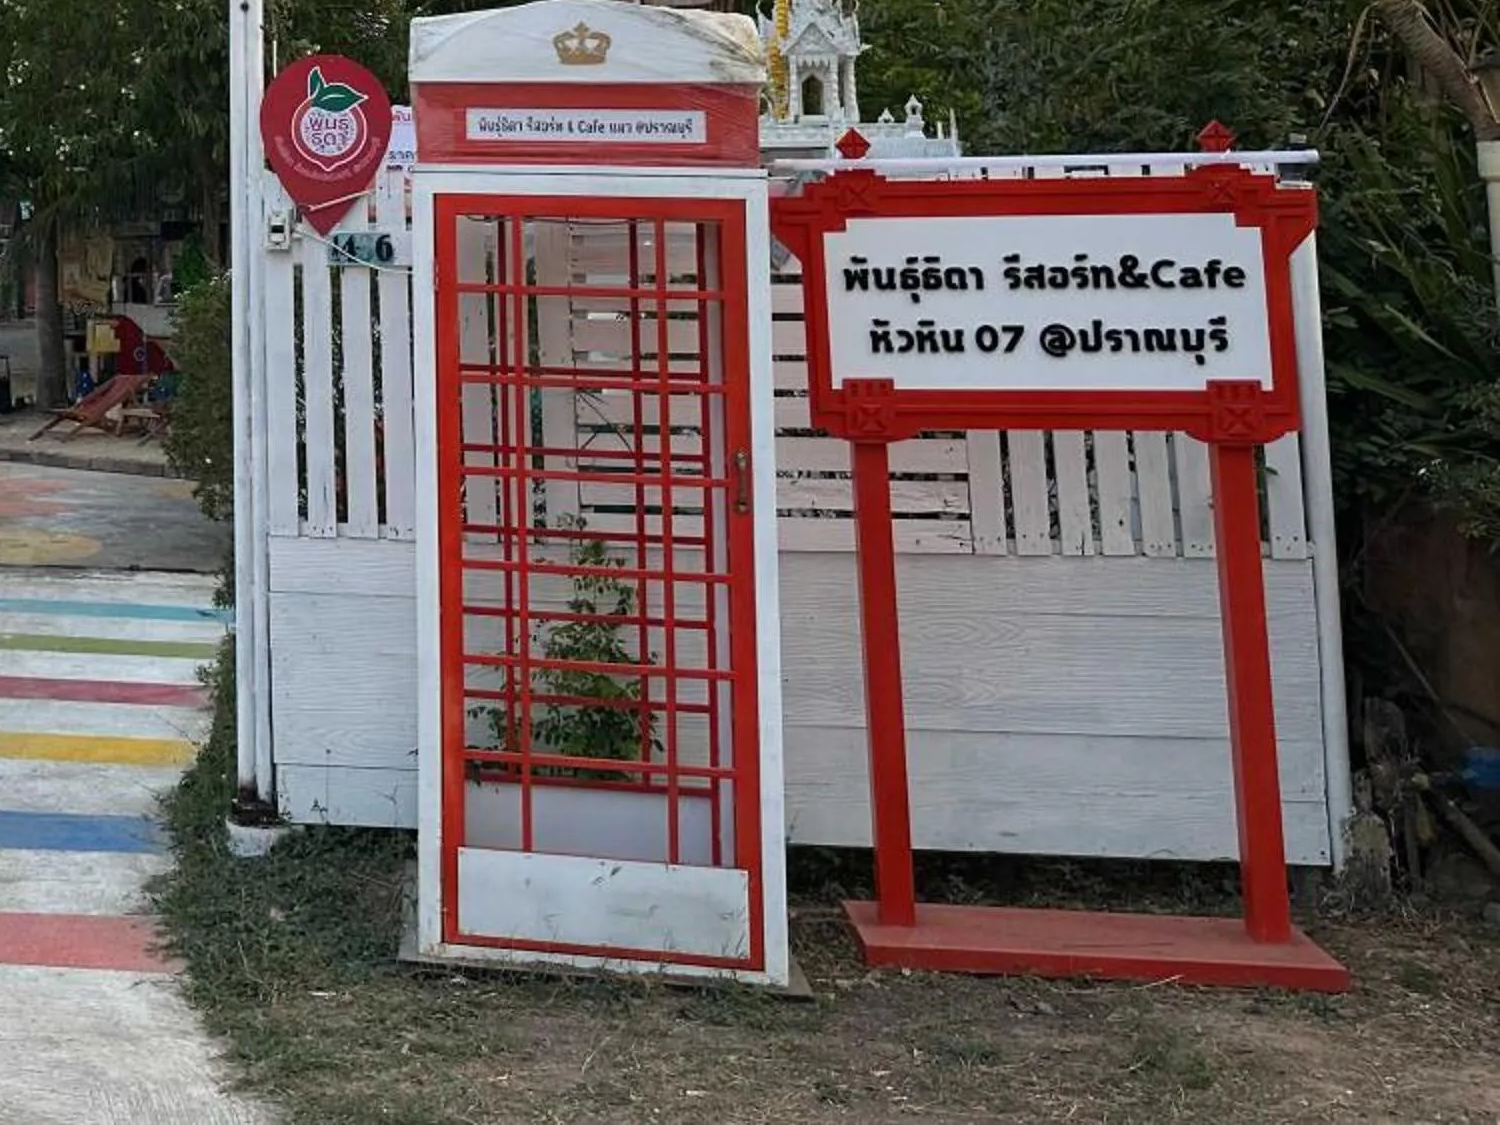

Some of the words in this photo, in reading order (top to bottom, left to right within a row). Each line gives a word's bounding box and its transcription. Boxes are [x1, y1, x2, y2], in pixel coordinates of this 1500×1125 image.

[577, 118, 605, 134] Cafe
[842, 255, 985, 303] พันธุ์ธิดา
[1002, 253, 1247, 291] รีสอร์ท&Cafe
[869, 318, 964, 354] หัวหิน
[975, 325, 1026, 354] 07
[1039, 316, 1230, 366] @ปราณบุรี
